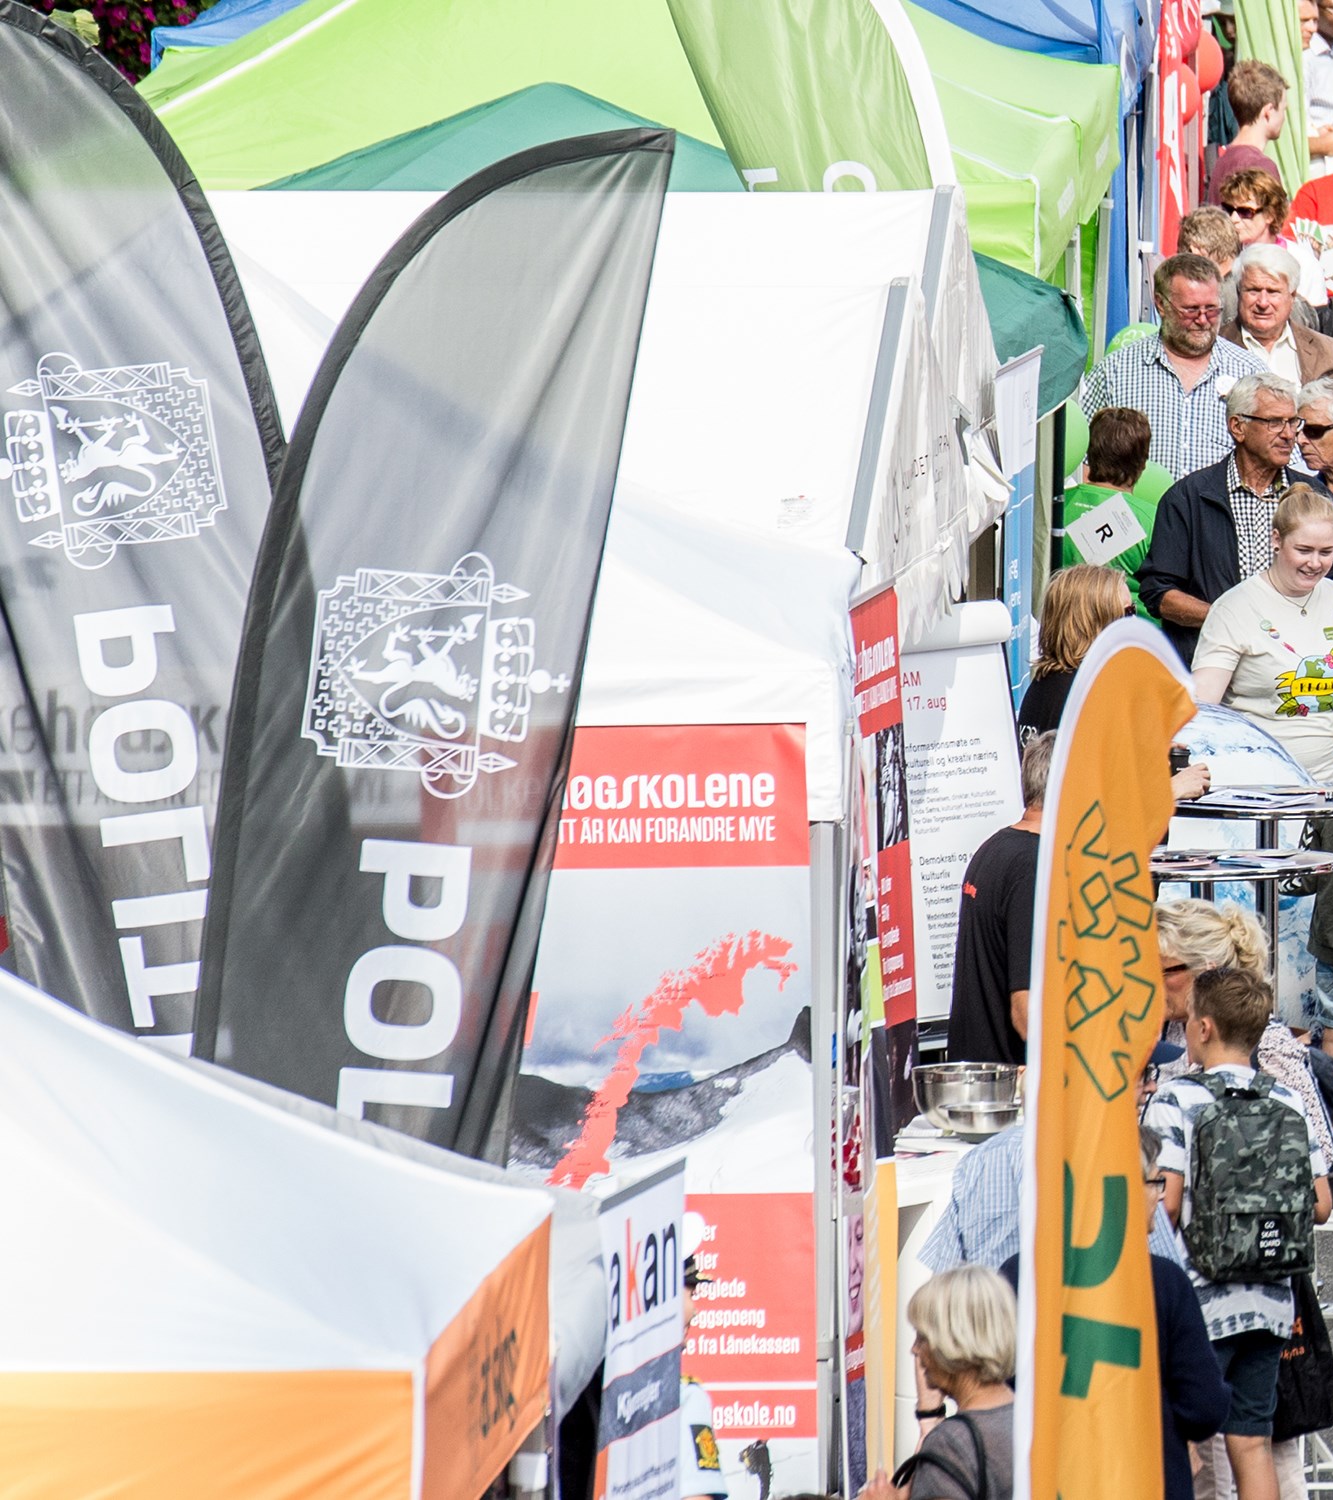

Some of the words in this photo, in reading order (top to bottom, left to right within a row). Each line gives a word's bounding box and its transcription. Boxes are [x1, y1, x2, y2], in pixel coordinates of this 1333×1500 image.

[1095, 523, 1114, 543] R
[906, 696, 925, 711] 17.
[927, 697, 947, 711] aug
[580, 815, 604, 844] ÅR
[607, 818, 644, 844] KAN
[645, 816, 735, 843] FORANDRE
[739, 815, 776, 842] MYE
[1261, 1229, 1279, 1239] SKATE
[1264, 1221, 1275, 1229] GO
[608, 1217, 678, 1333] akan
[698, 1334, 717, 1355] fra
[719, 1333, 800, 1355] Lånekassen
